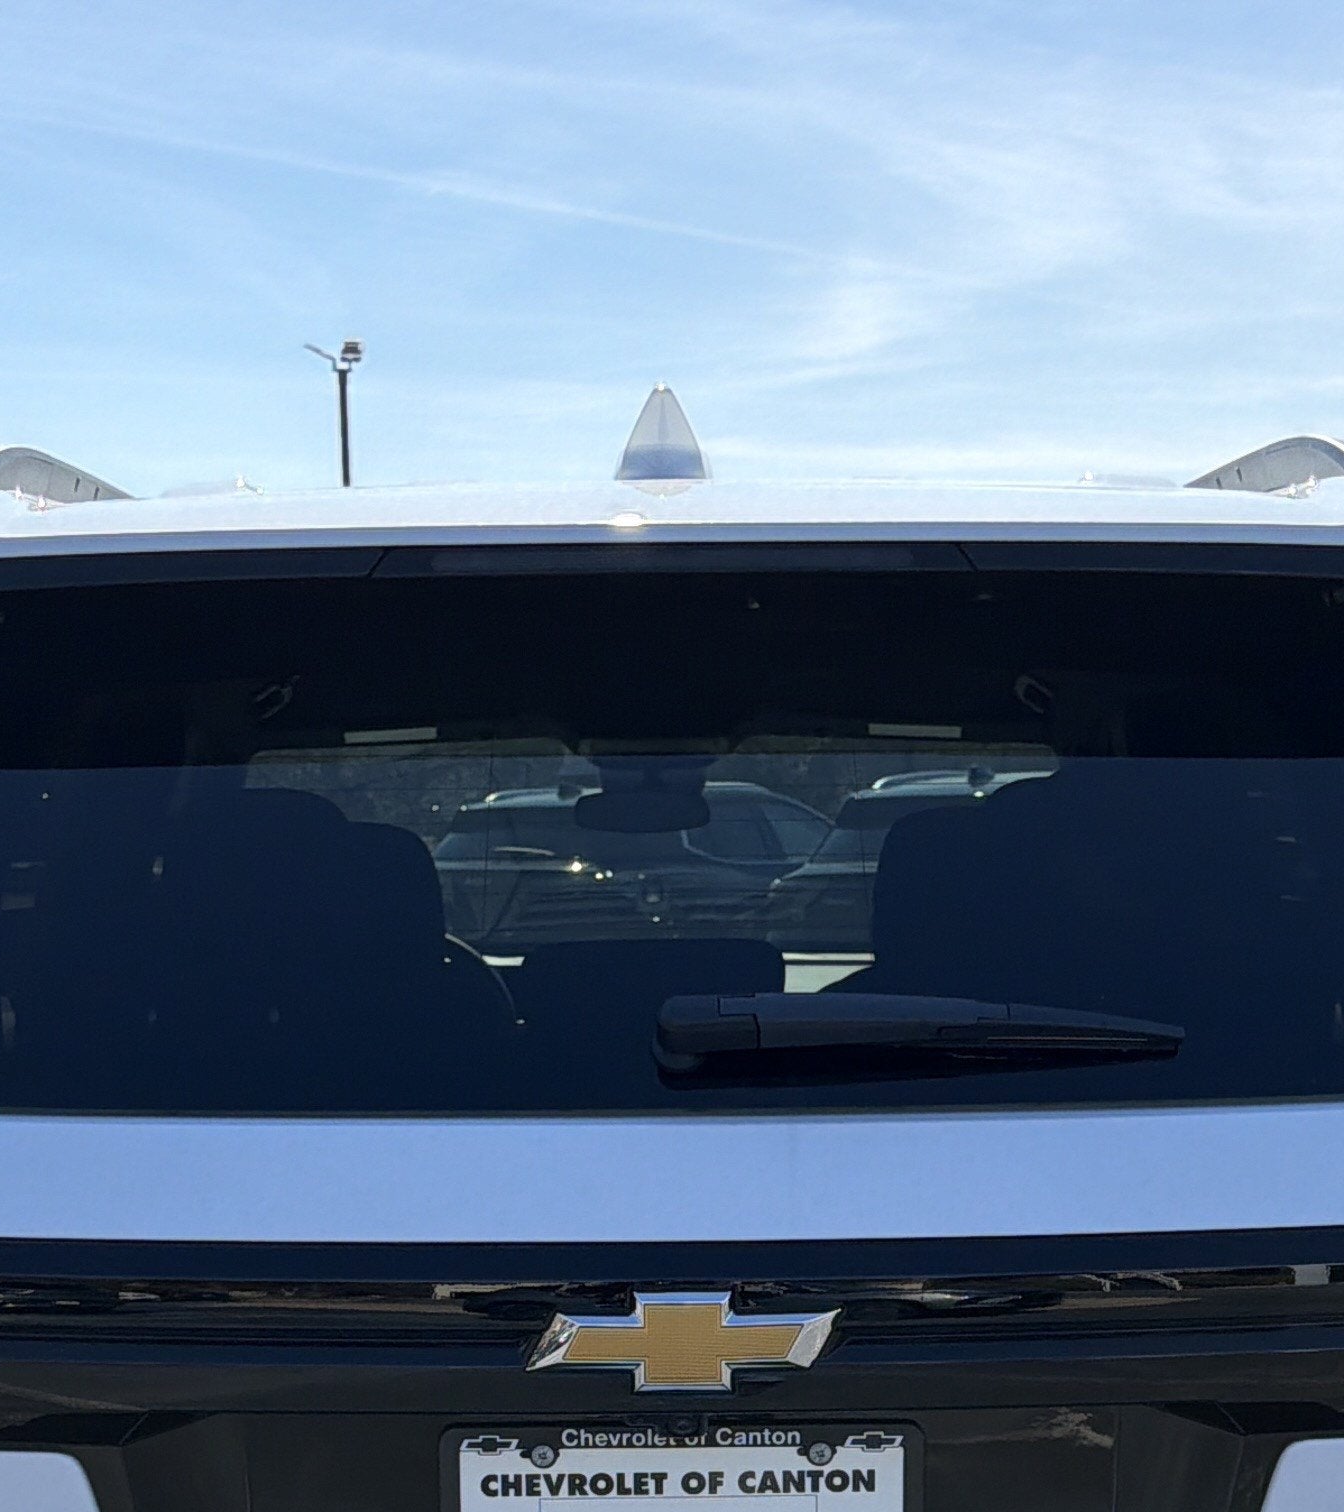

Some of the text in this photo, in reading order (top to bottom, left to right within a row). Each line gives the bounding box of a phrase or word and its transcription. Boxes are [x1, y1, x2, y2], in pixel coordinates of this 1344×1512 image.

[716, 1427, 801, 1446] Canton
[480, 1469, 877, 1498] CHEVROLET OF CANTON
